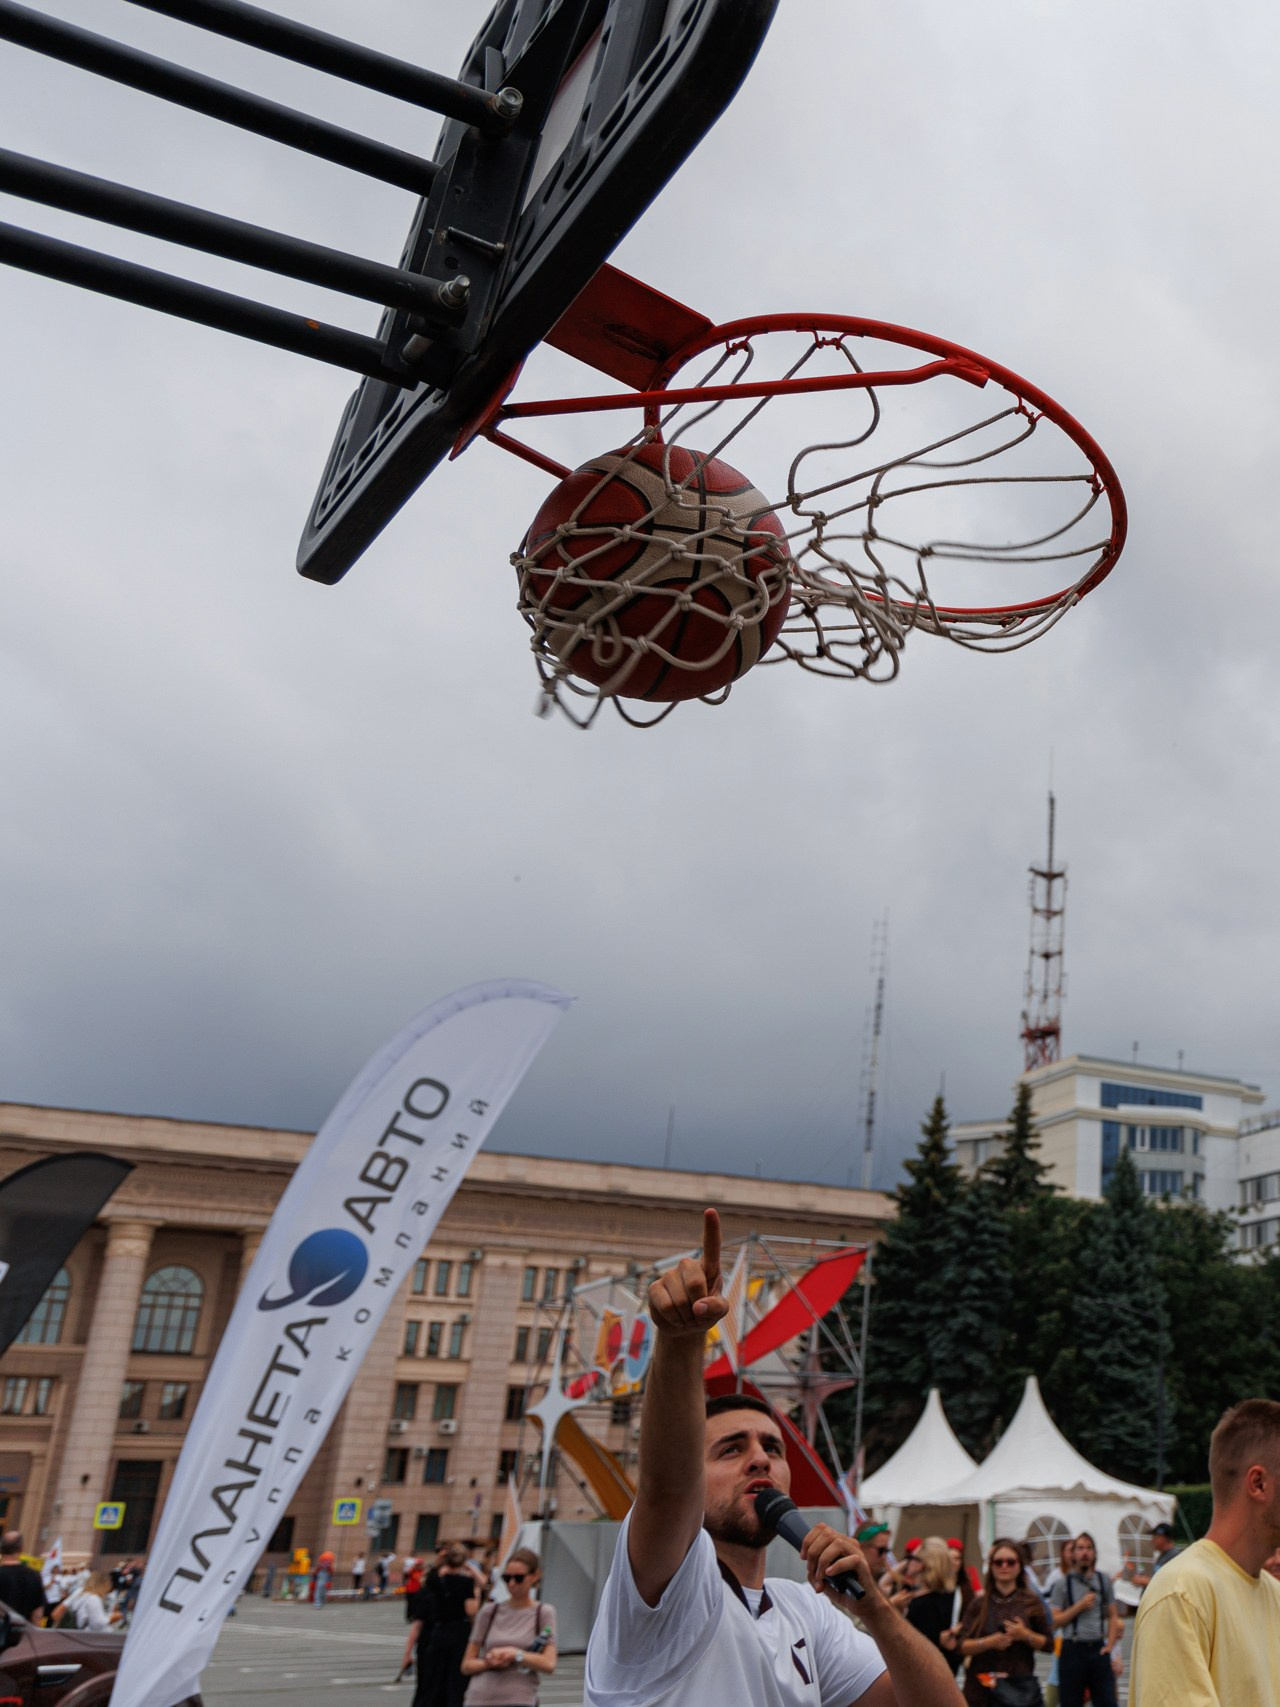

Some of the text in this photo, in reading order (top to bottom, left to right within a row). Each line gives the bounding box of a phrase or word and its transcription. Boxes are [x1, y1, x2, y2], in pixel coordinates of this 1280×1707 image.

[159, 1077, 451, 1613] ПЛАНЕТА АВТО
[336, 1099, 489, 1362] компаний
